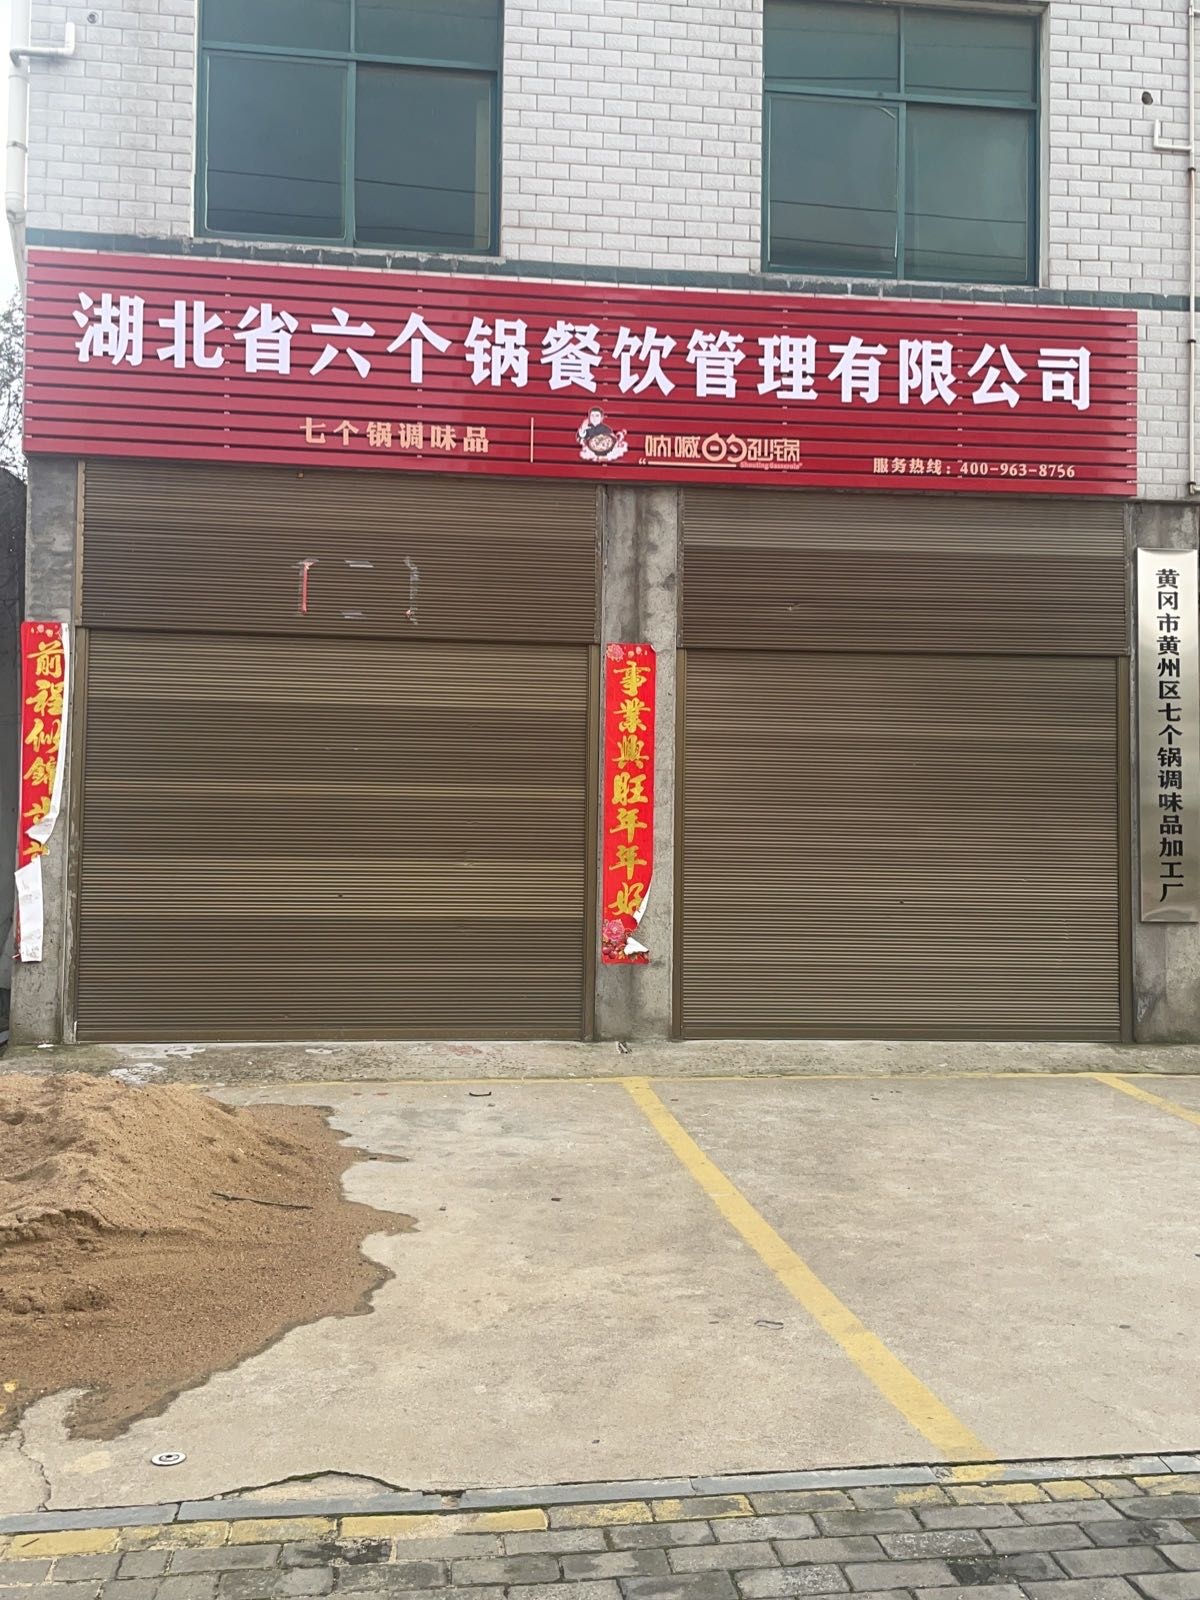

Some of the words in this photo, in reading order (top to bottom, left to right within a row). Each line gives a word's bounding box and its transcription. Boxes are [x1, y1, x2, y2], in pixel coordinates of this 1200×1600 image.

[71, 291, 1092, 411] 湖北省六个锅餐饮管理有限公司
[300, 417, 490, 454] 七个锅调味品
[1155, 568, 1185, 903] 黄冈市黄州区七个锅调味品加工厂
